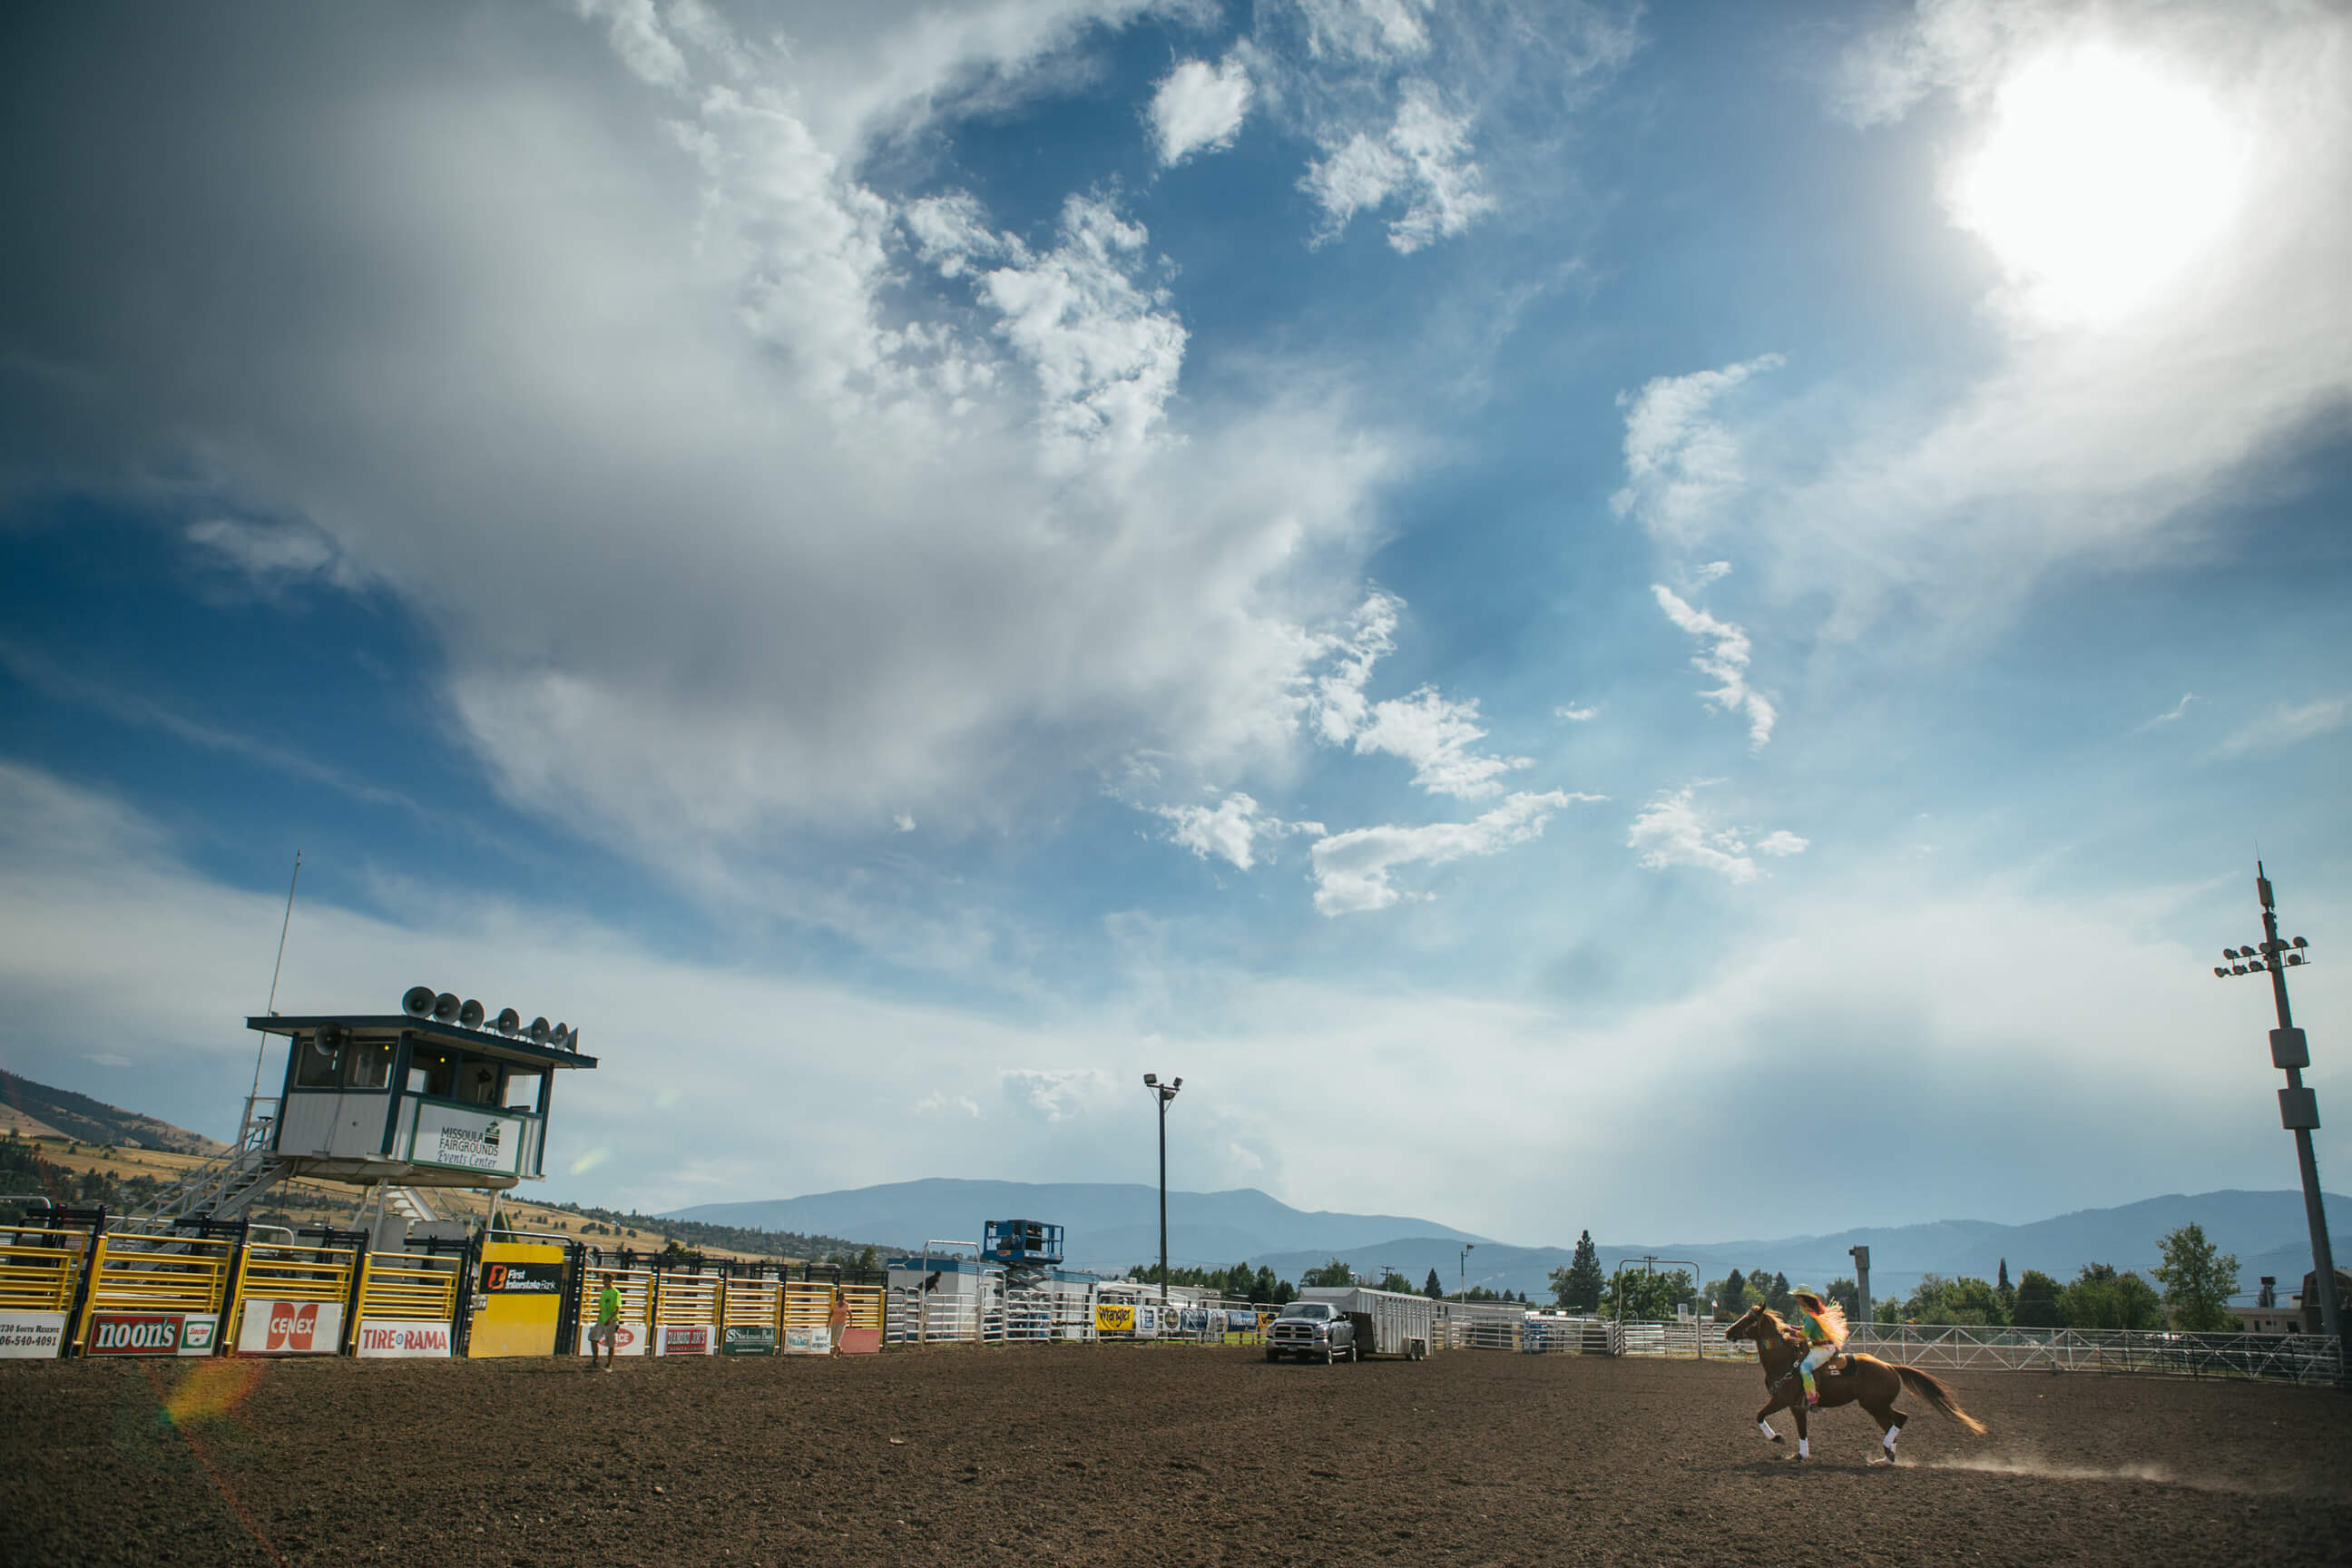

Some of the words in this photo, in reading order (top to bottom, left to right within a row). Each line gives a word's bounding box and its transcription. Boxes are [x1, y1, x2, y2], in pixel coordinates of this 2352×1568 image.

[441, 1126, 484, 1142] MISSOULA
[438, 1138, 499, 1156] FAIRGROUNDS
[436, 1149, 467, 1165] Events
[469, 1153, 498, 1169] Center
[507, 1269, 526, 1279] First
[505, 1279, 540, 1290] Interstate
[271, 1317, 314, 1334] CENEX
[1099, 1307, 1131, 1328] Wrangler
[94, 1318, 176, 1348] noon's
[363, 1328, 397, 1349] TIRE
[404, 1329, 447, 1350] RAMA
